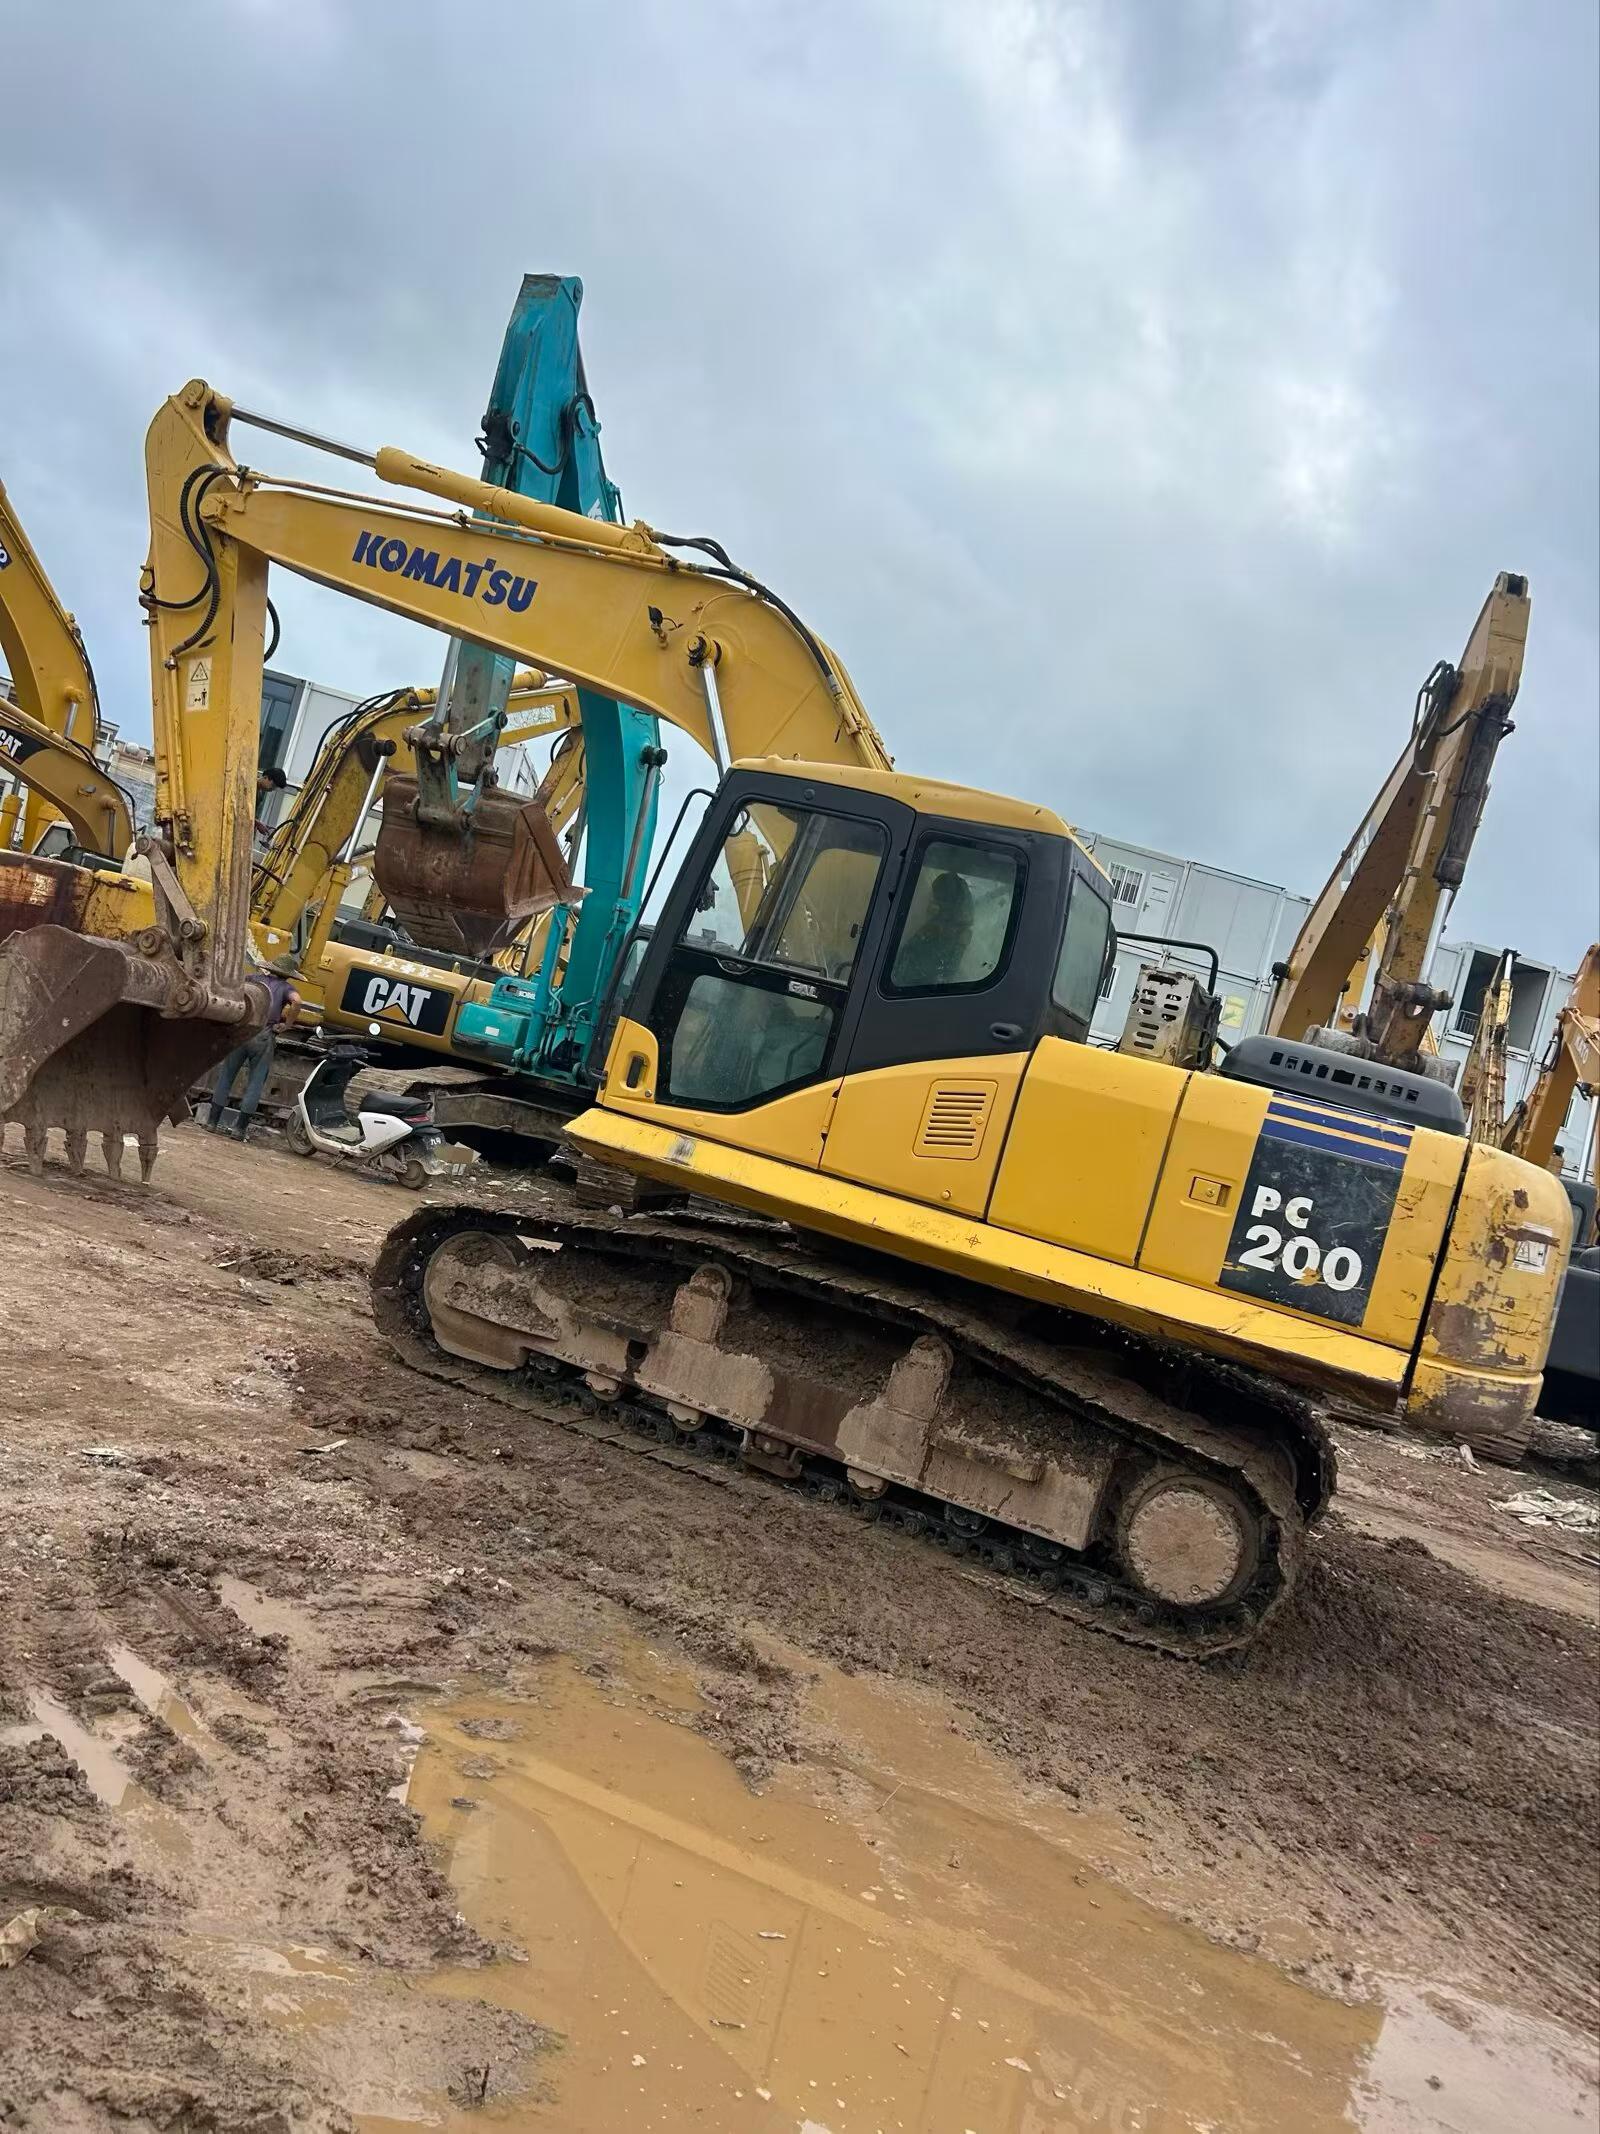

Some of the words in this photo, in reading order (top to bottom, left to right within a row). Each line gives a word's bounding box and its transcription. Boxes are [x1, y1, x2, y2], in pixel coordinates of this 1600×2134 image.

[352, 530, 539, 613] KOMATSU
[363, 977, 432, 1026] CAT
[1250, 1184, 1314, 1229] PC
[1238, 1224, 1362, 1291] 200
